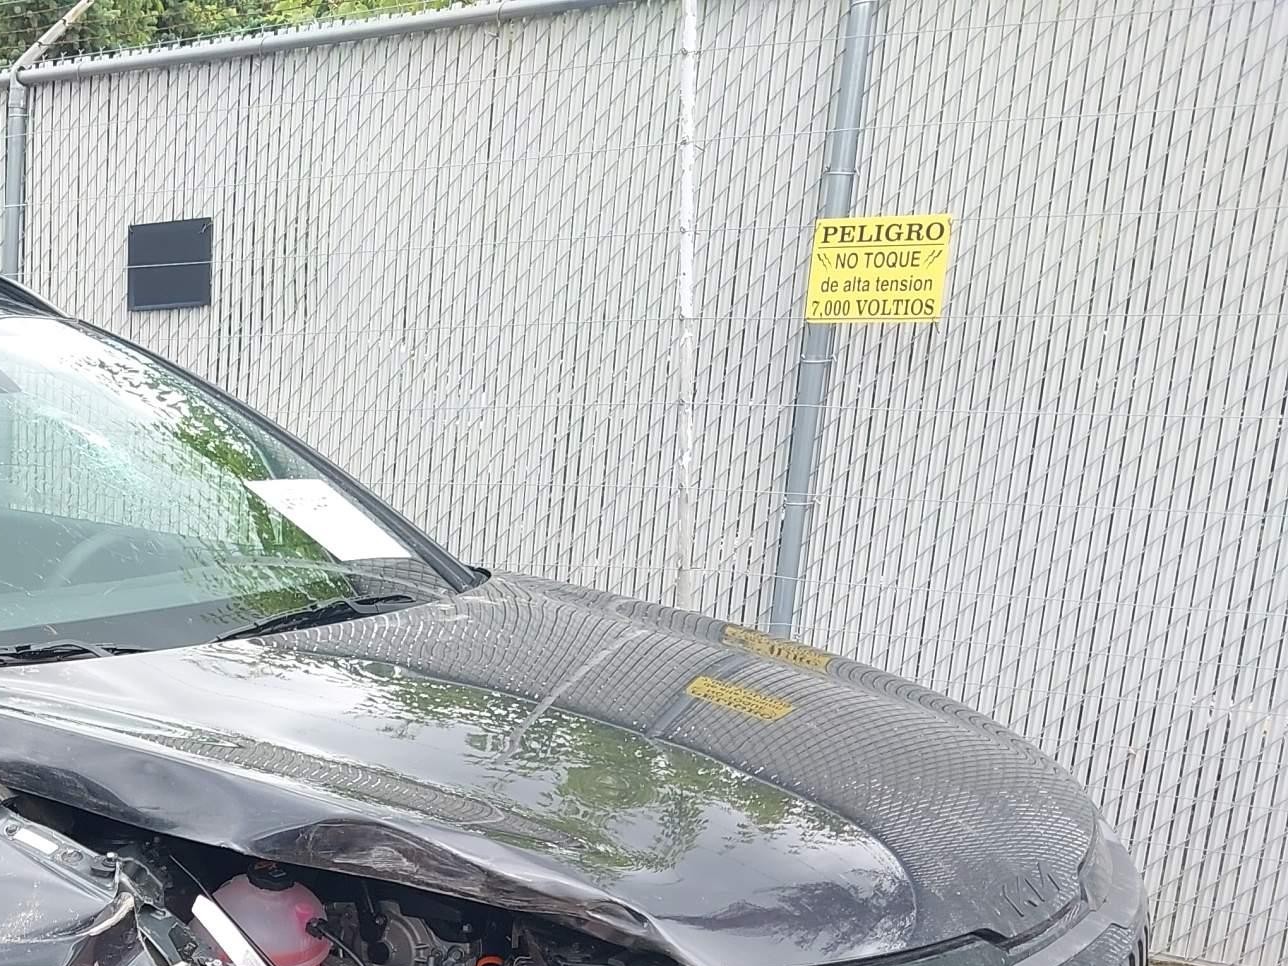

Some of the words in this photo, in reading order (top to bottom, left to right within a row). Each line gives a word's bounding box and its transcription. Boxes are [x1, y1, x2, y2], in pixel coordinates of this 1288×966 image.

[821, 222, 945, 244] PELIGRO
[835, 252, 859, 269] NO
[864, 251, 922, 269] TOQUE
[820, 276, 839, 293] de
[843, 276, 870, 293] alta
[875, 275, 933, 292] tension
[856, 298, 935, 316] VOLTIOS
